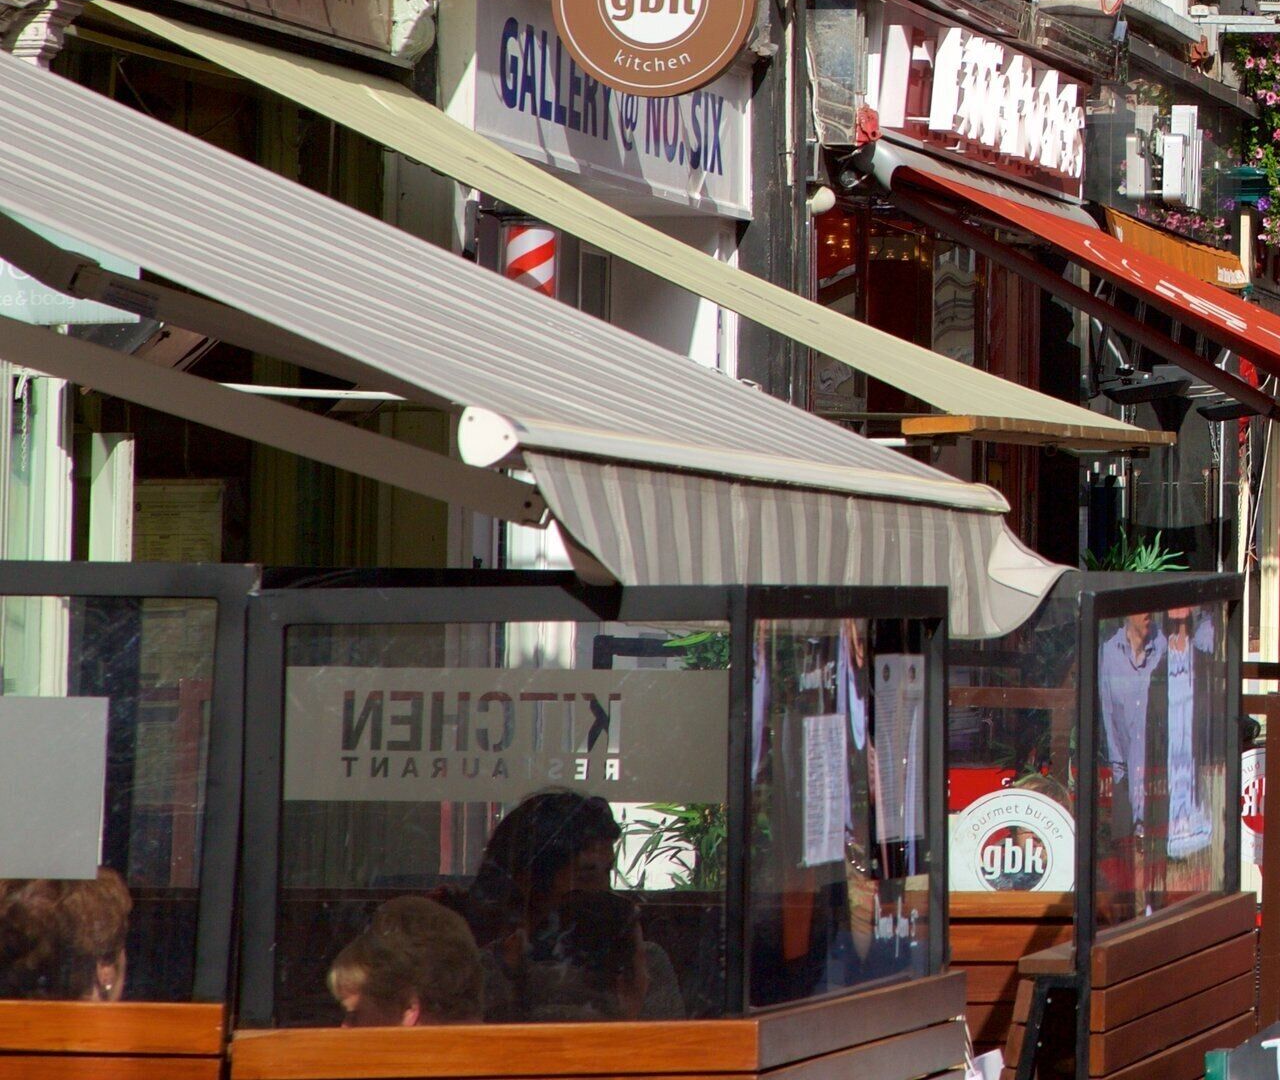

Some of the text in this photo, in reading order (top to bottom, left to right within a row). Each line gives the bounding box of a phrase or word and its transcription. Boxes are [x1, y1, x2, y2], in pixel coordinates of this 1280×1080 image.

[613, 49, 692, 73] kitchen
[689, 92, 724, 177] SIX
[1024, 805, 1063, 842] burger
[983, 837, 1045, 880] gbk
